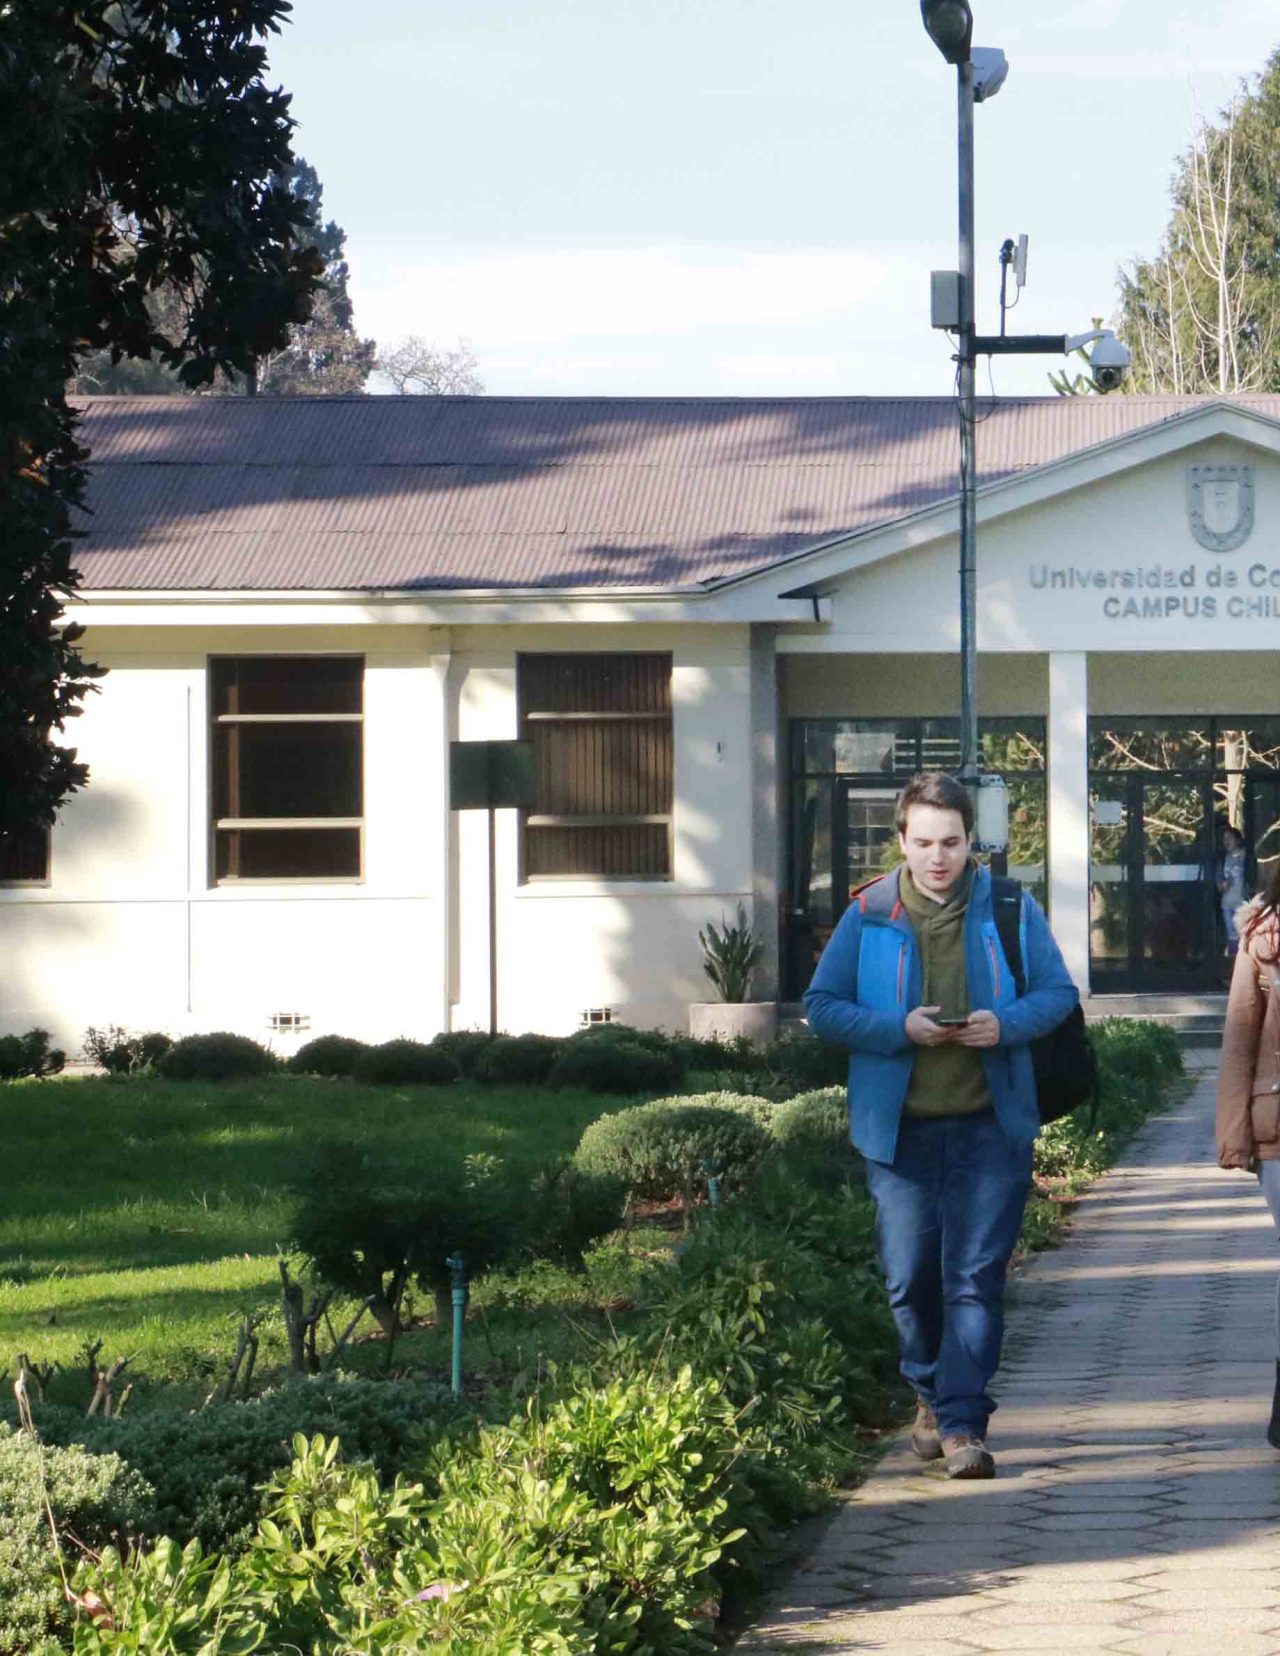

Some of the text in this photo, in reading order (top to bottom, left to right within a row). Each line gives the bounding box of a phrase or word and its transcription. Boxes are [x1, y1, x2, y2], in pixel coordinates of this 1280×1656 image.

[1029, 564, 1196, 589] Universidad
[1206, 564, 1238, 588] de
[1103, 596, 1217, 618] CAMPUS
